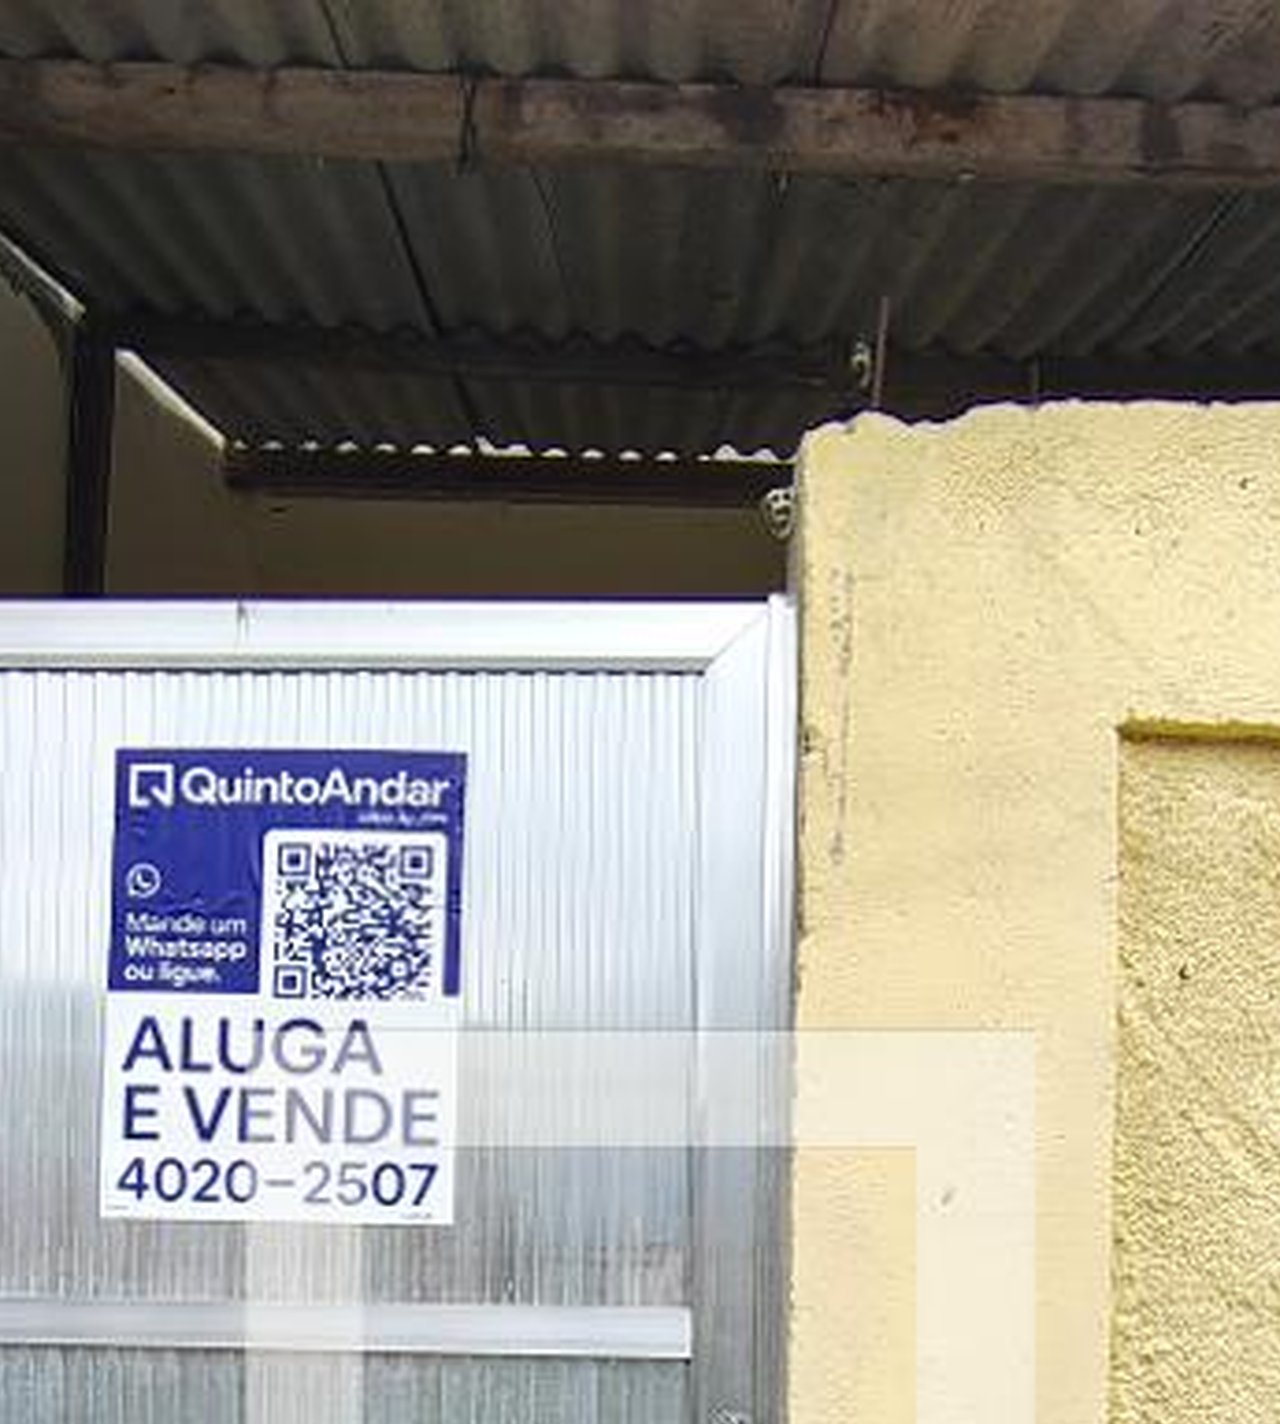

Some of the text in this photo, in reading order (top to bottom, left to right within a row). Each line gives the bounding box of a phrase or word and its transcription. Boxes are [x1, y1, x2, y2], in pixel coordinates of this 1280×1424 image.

[180, 767, 451, 808] QuintoAndar
[125, 912, 247, 934] Mande um
[125, 935, 247, 962] Whatsapp
[124, 963, 154, 981] ou
[122, 1016, 383, 1075] ALUGA
[123, 1085, 439, 1146] E VENDE
[117, 1157, 439, 1206] 4020-2507
